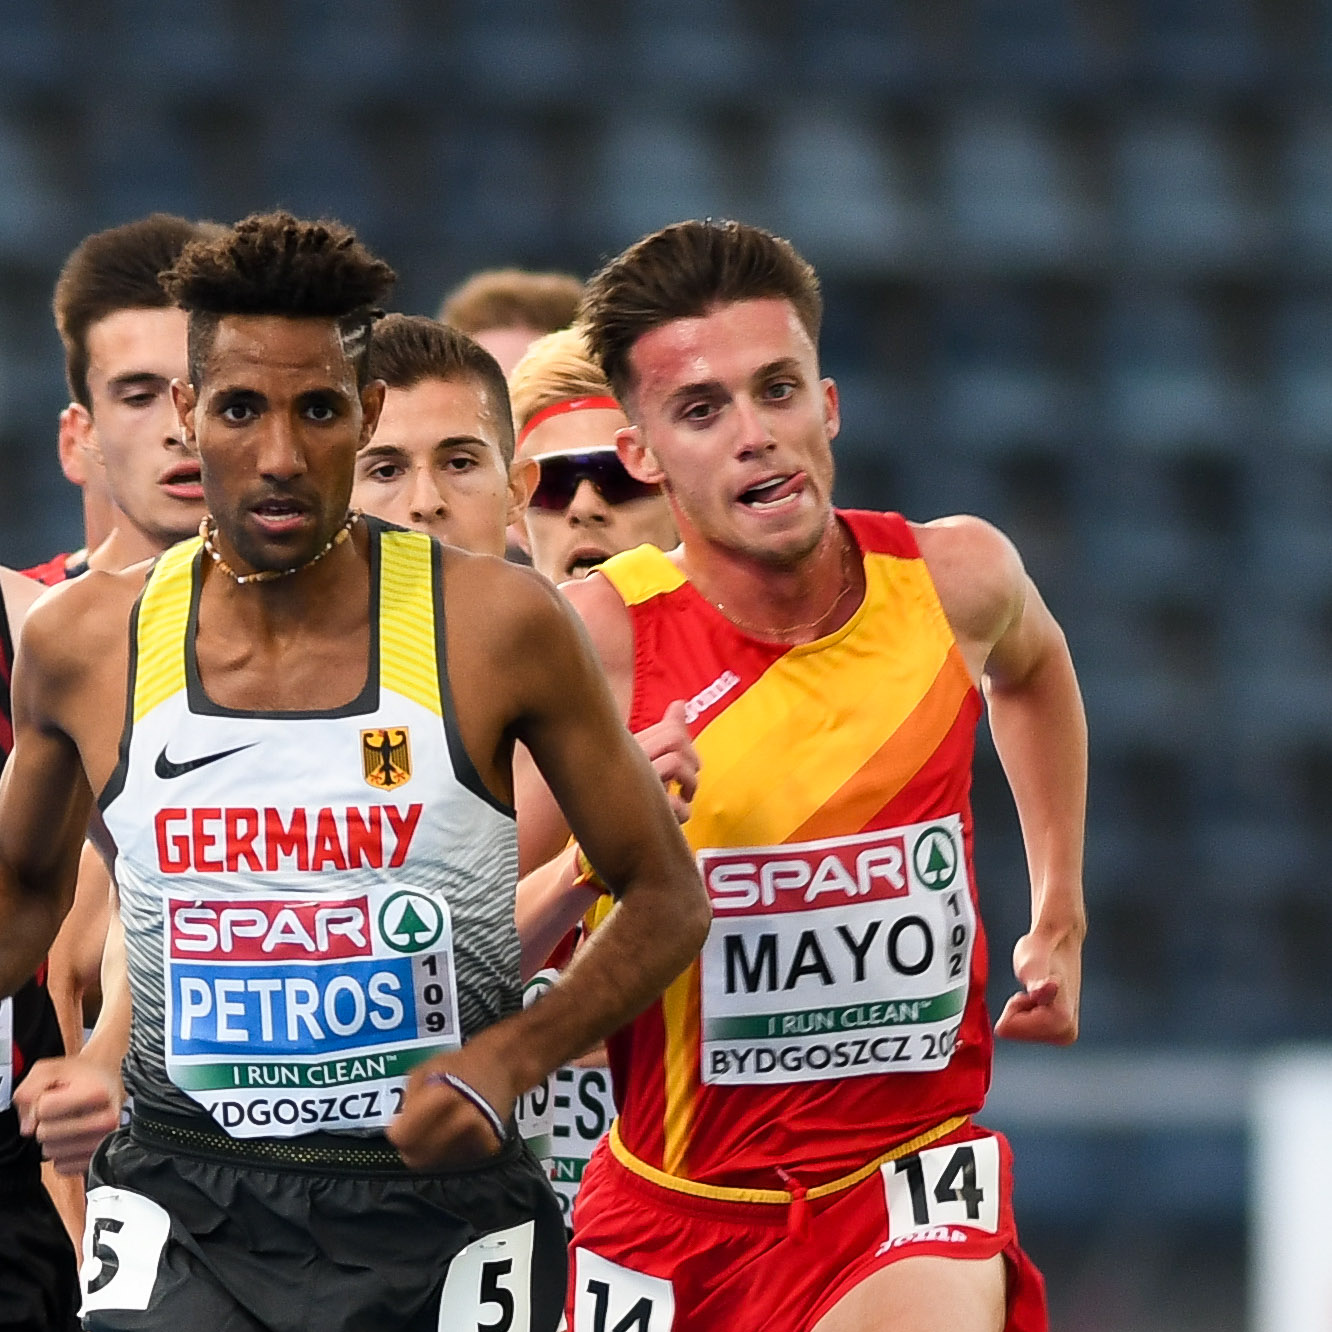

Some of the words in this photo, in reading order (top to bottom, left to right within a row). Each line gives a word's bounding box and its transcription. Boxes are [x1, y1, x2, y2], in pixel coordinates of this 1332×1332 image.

[154, 803, 423, 873] GERMANY
[709, 845, 906, 909] SPAR
[174, 907, 368, 952] SPAR
[724, 916, 935, 994] MAYO
[179, 971, 404, 1043] PETROS
[768, 1017, 775, 1035] I
[782, 1010, 835, 1034] RUN
[233, 1066, 240, 1085] I
[247, 1066, 300, 1085] RUN
[711, 1035, 911, 1074] BYDGOSZCZ
[893, 1145, 985, 1226] 14
[86, 1217, 125, 1295] 5
